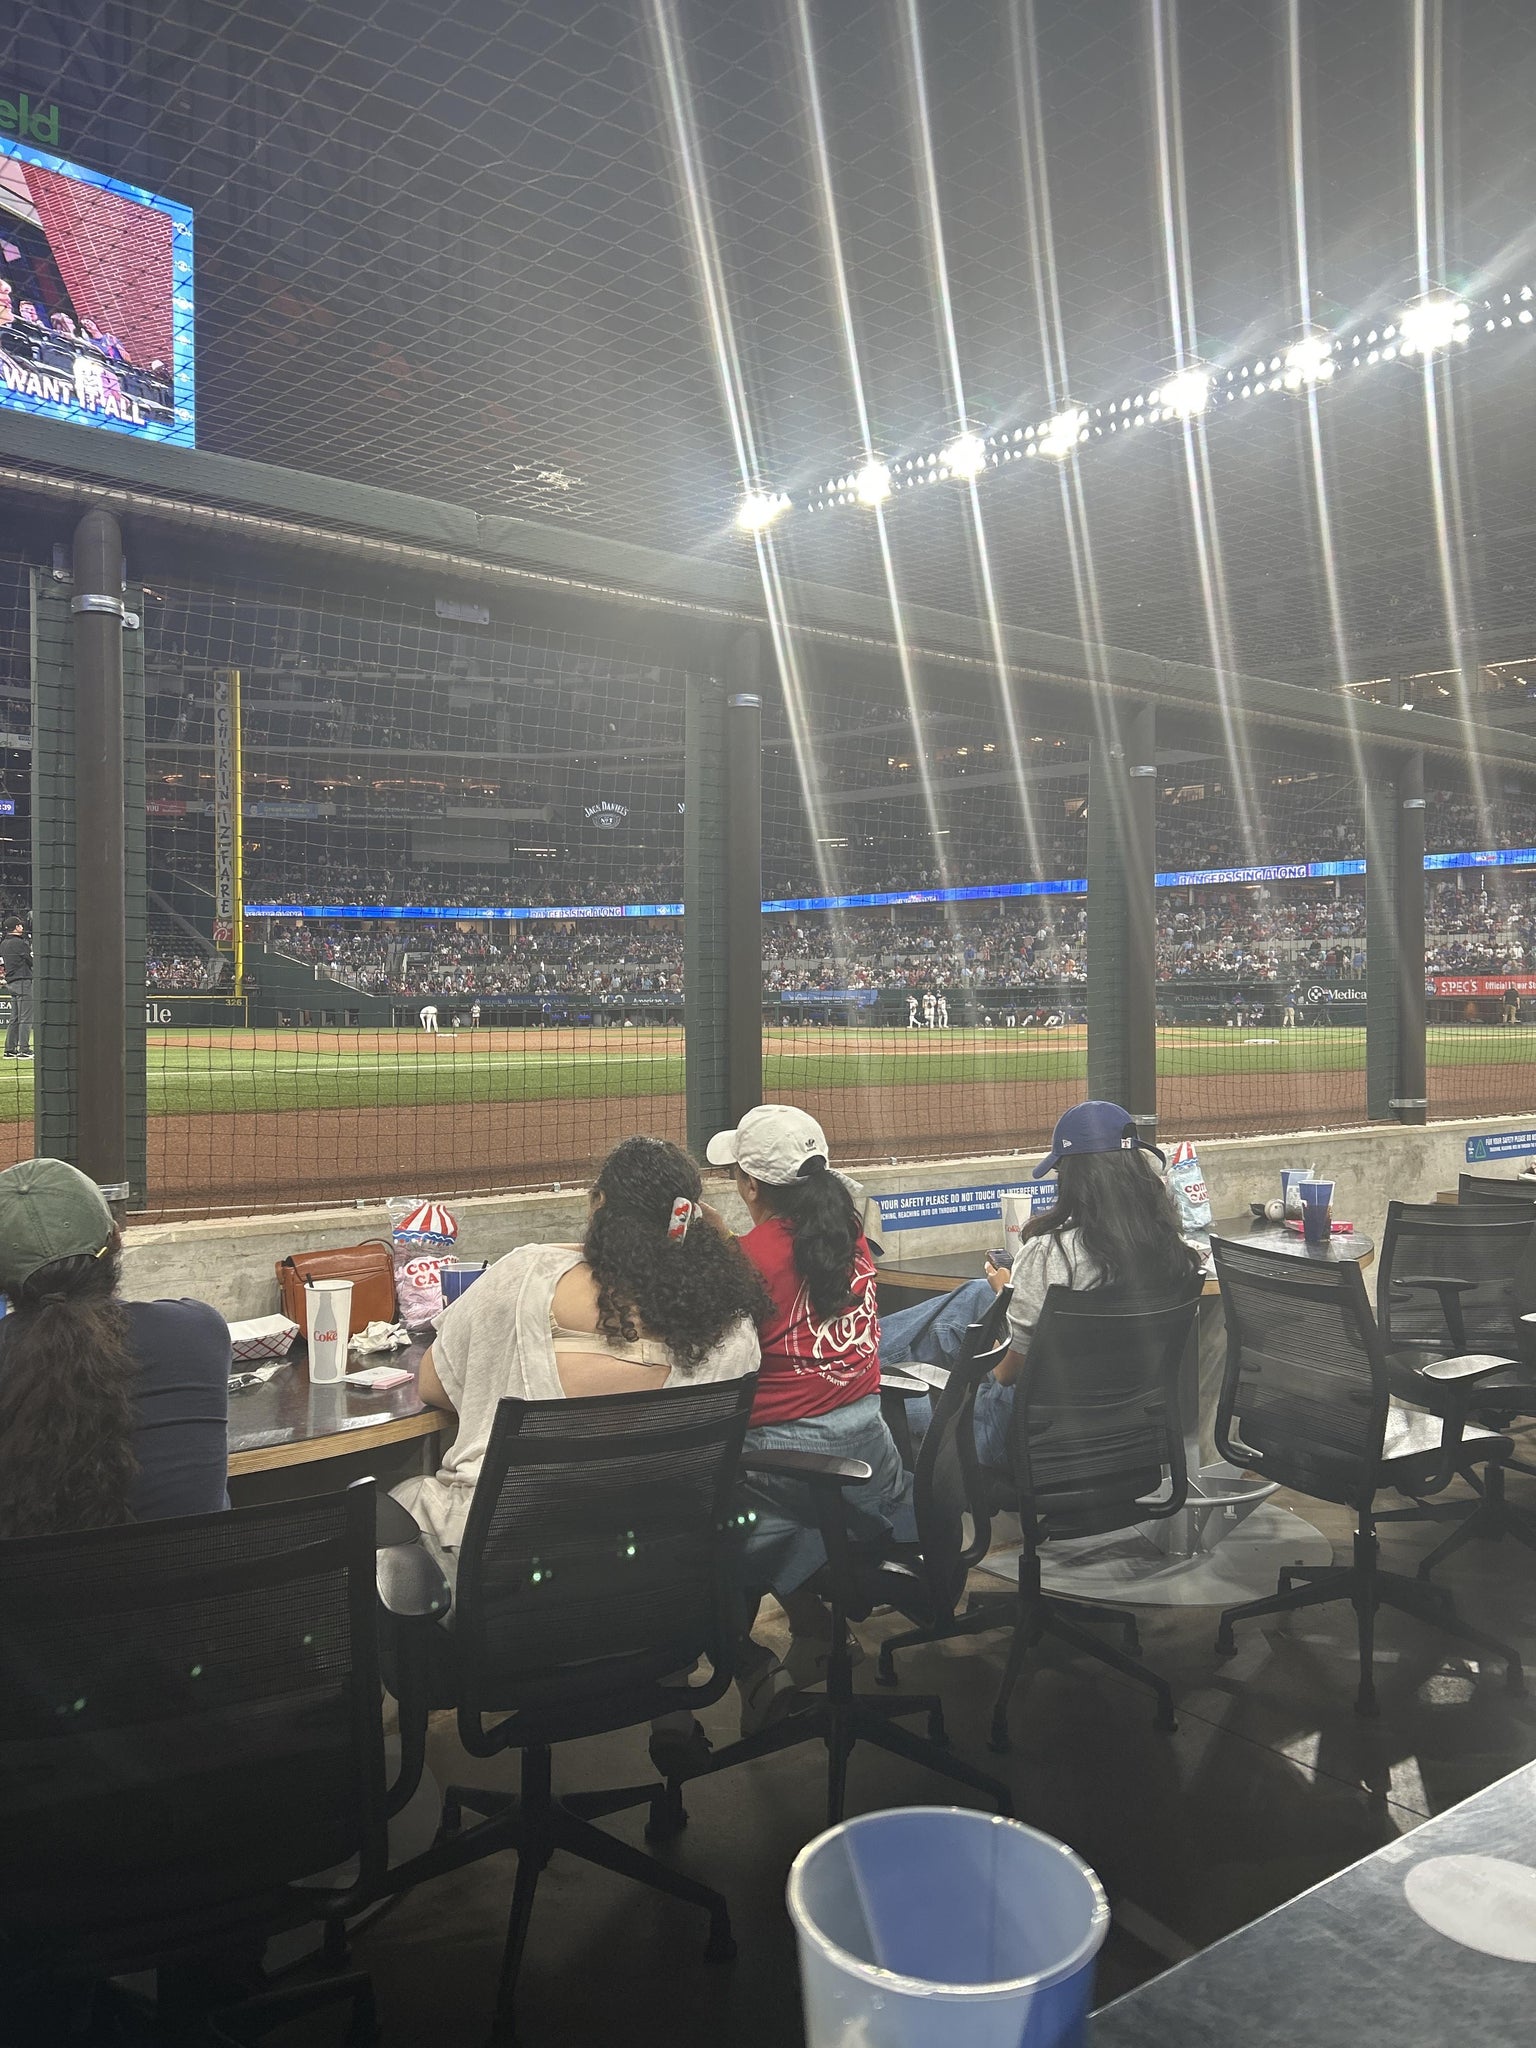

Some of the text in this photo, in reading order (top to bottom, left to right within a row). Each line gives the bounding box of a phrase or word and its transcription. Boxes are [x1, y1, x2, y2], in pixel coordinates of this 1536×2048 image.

[2, 364, 73, 407] WANT
[105, 394, 147, 427] ALL
[1235, 868, 1263, 882] SING
[1264, 865, 1306, 880] ALONG
[1441, 979, 1478, 992] SPEC'S
[225, 999, 242, 1007] 326
[881, 1199, 898, 1210] YOUR
[900, 1196, 924, 1208] SAFETY
[925, 1194, 949, 1206] PLEASE
[951, 1193, 959, 1203] DO
[962, 1192, 973, 1202] NOT
[975, 1190, 995, 1200] TOUCH
[1040, 1184, 1055, 1194] WITH
[959, 1204, 967, 1212] THE
[314, 1330, 337, 1342] Coke
